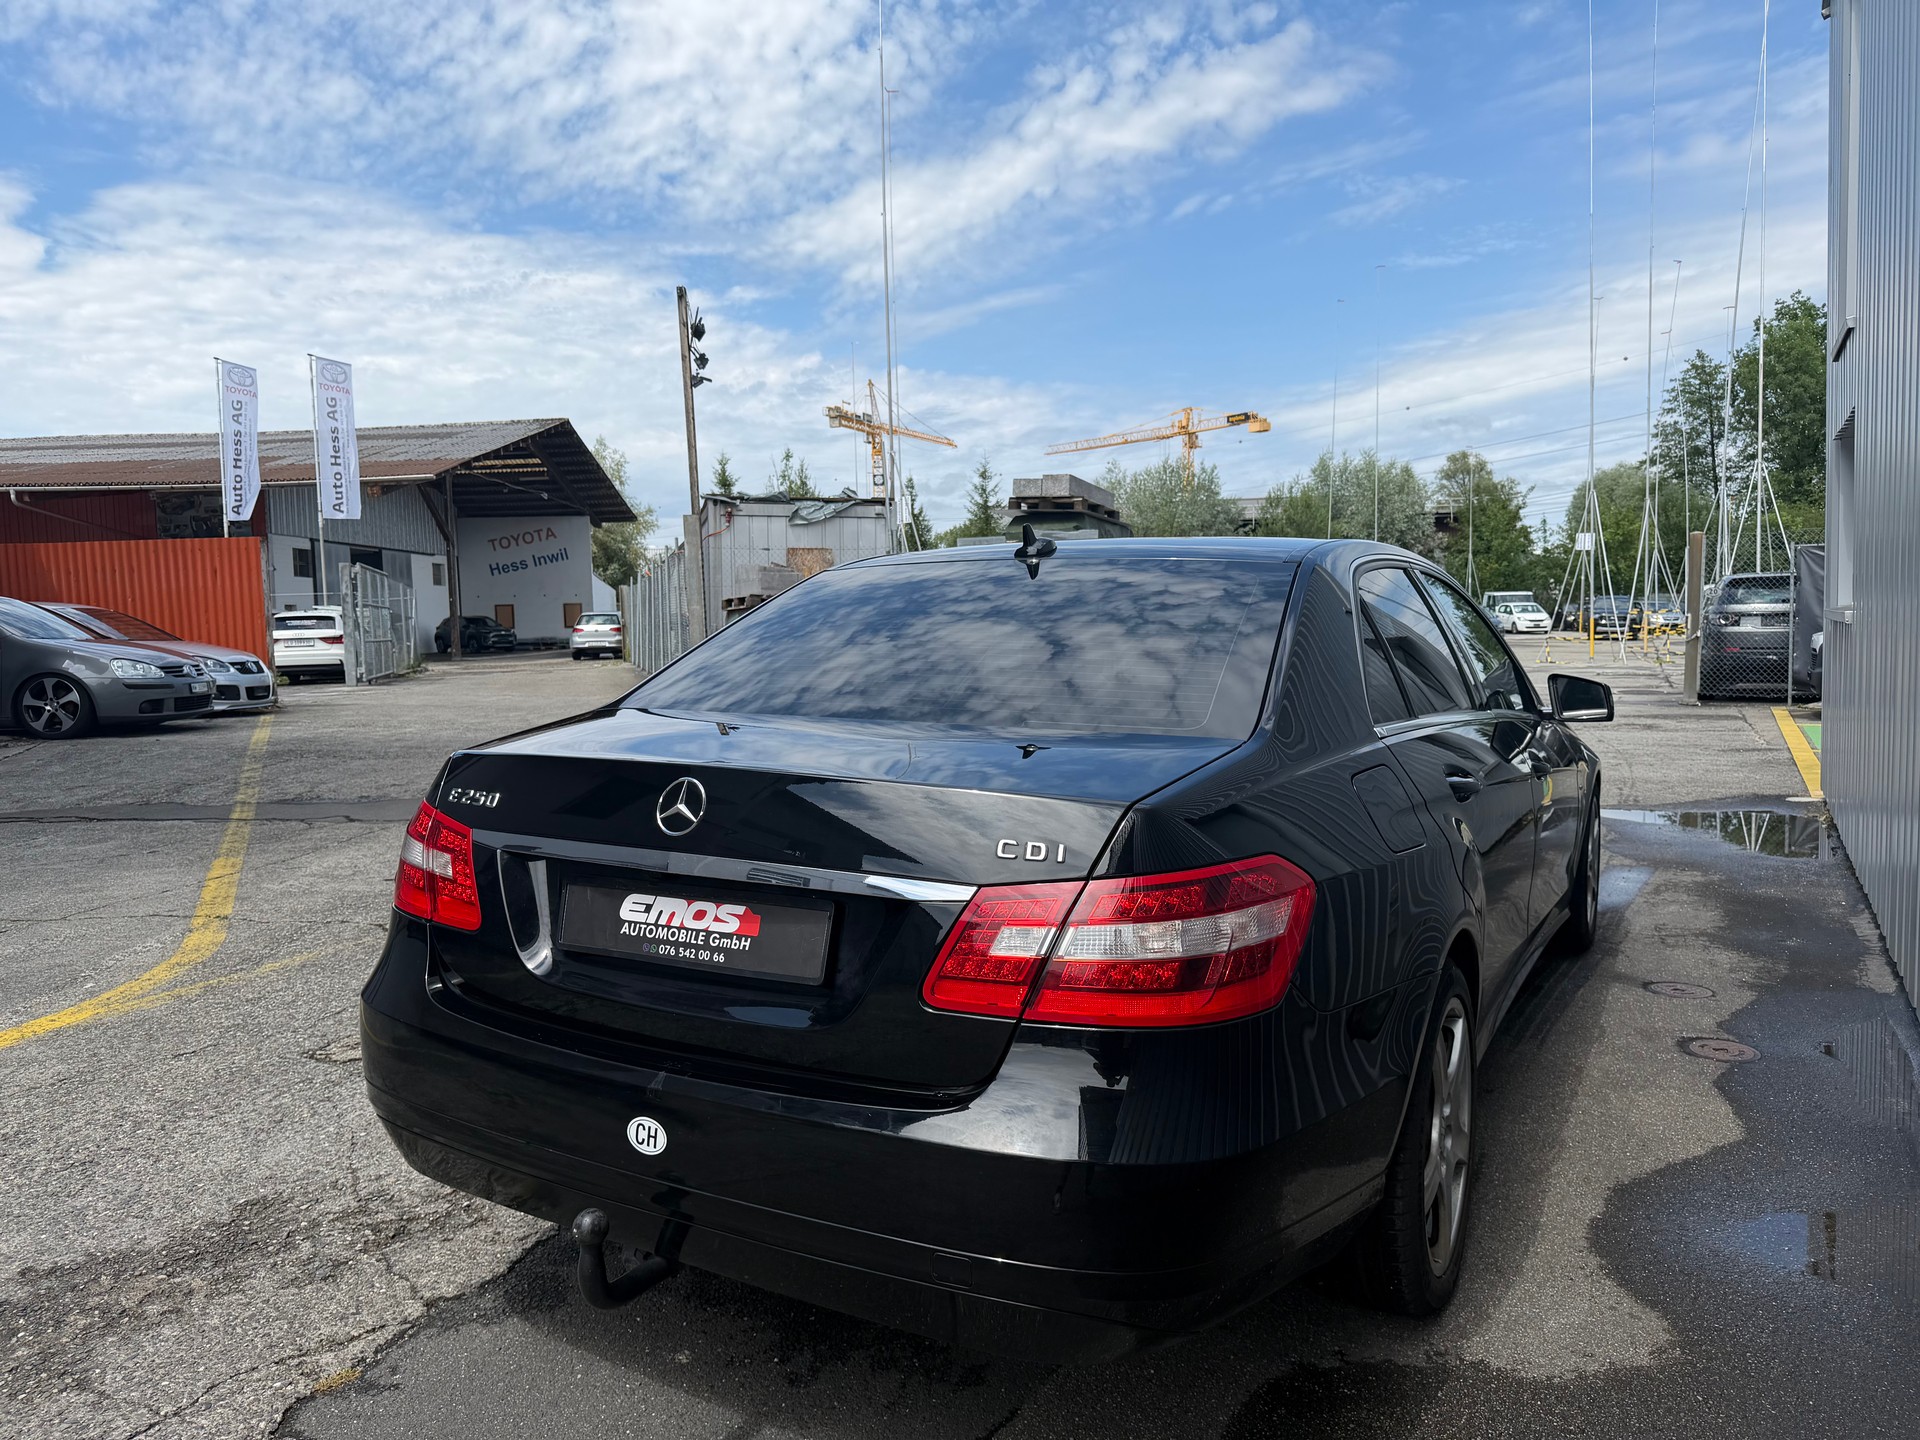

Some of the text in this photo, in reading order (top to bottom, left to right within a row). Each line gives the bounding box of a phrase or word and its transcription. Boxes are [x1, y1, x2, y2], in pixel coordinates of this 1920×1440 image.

[225, 385, 257, 400] TOYOTA
[319, 382, 351, 396] TOYOTA
[326, 396, 338, 422] AG
[231, 399, 243, 516] Auto Hess AG
[330, 426, 342, 467] Hess
[332, 471, 344, 514] Auto
[487, 527, 557, 552] TOYOTA
[489, 547, 569, 577] Hess Inwil
[996, 839, 1066, 863] CDI
[619, 893, 747, 933] EMOS
[620, 922, 751, 951] AUTOMOBILE GmbH
[658, 944, 725, 963] 076 542 00 66
[635, 1122, 658, 1149] CH
